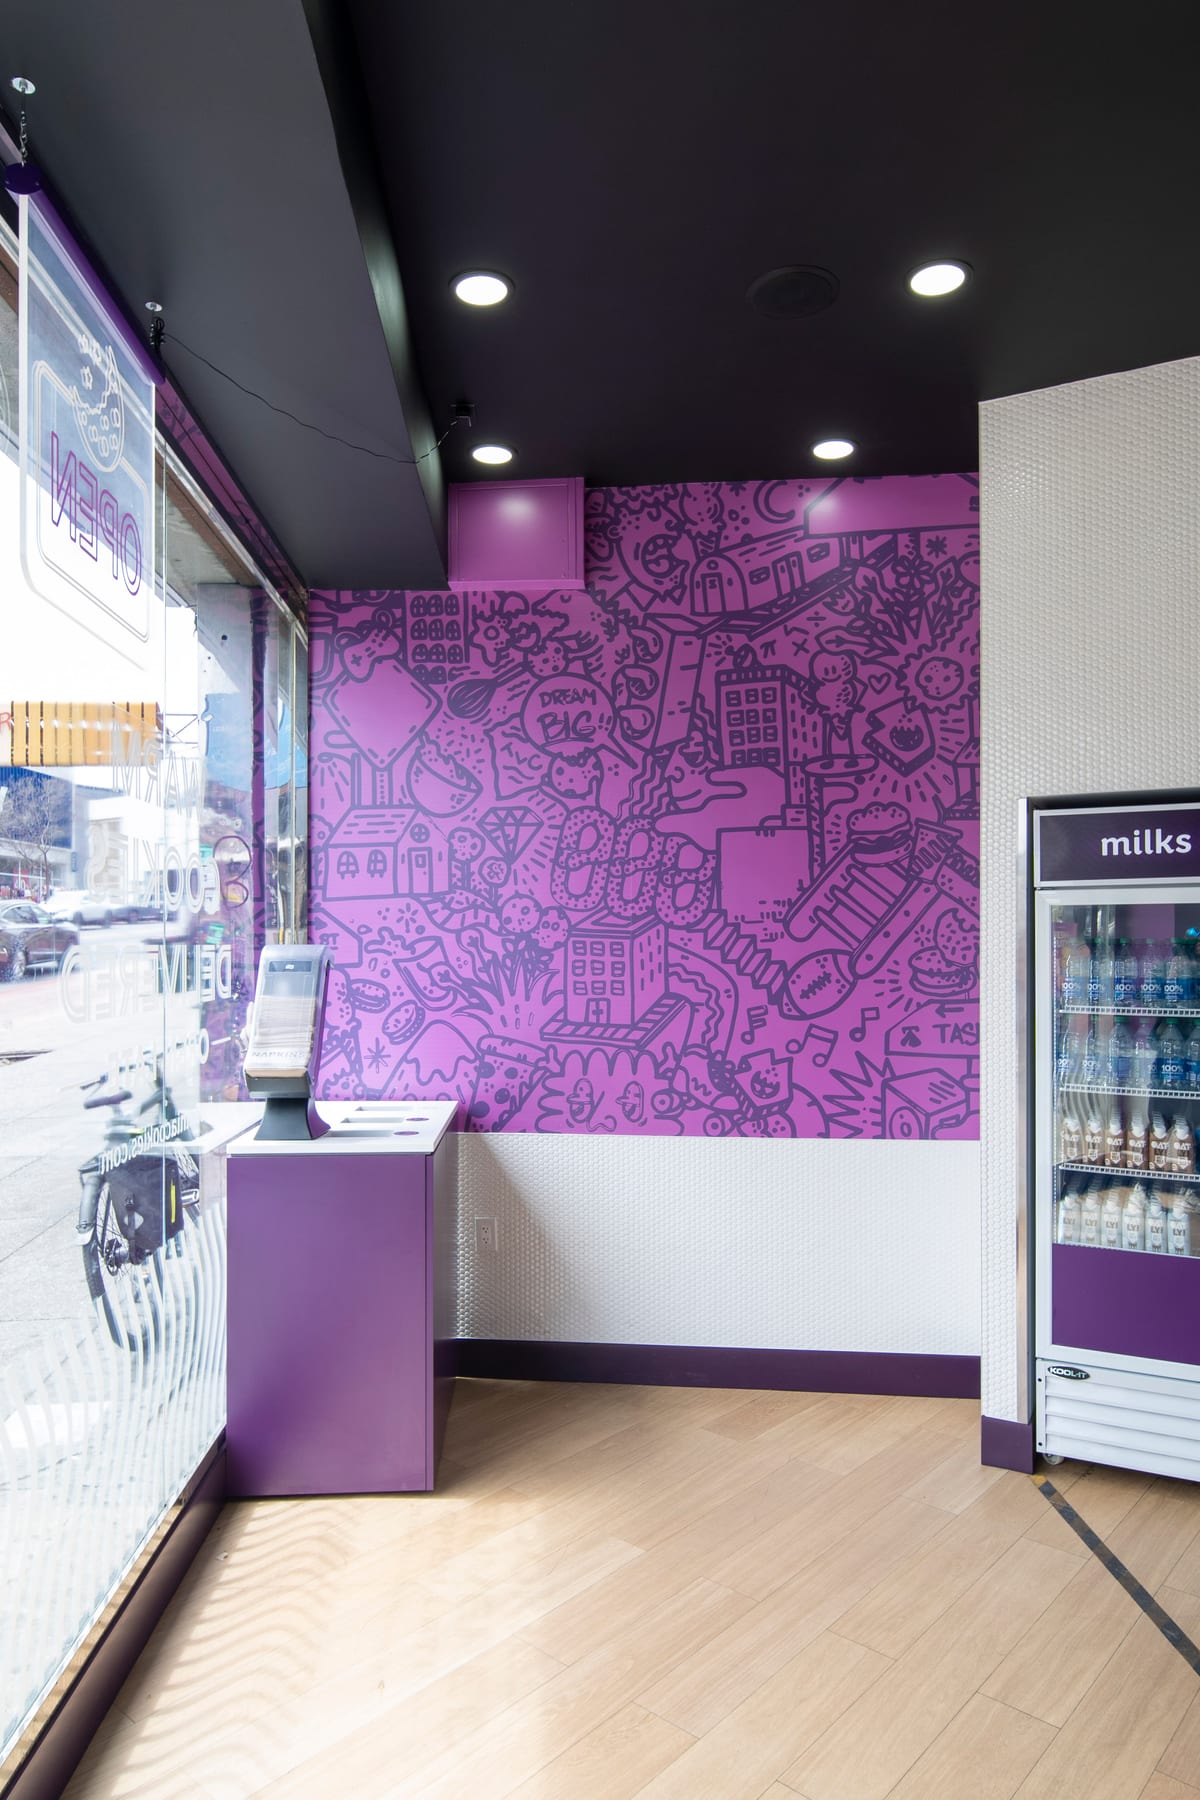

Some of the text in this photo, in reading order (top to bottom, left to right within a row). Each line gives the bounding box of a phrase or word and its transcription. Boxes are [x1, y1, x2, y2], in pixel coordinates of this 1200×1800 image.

[538, 687, 597, 708] DREAM
[500, 741, 543, 770] TLC
[1101, 829, 1192, 857] milks
[1161, 1064, 1184, 1073] 100%
[1050, 1367, 1086, 1379] KOOL-IT
